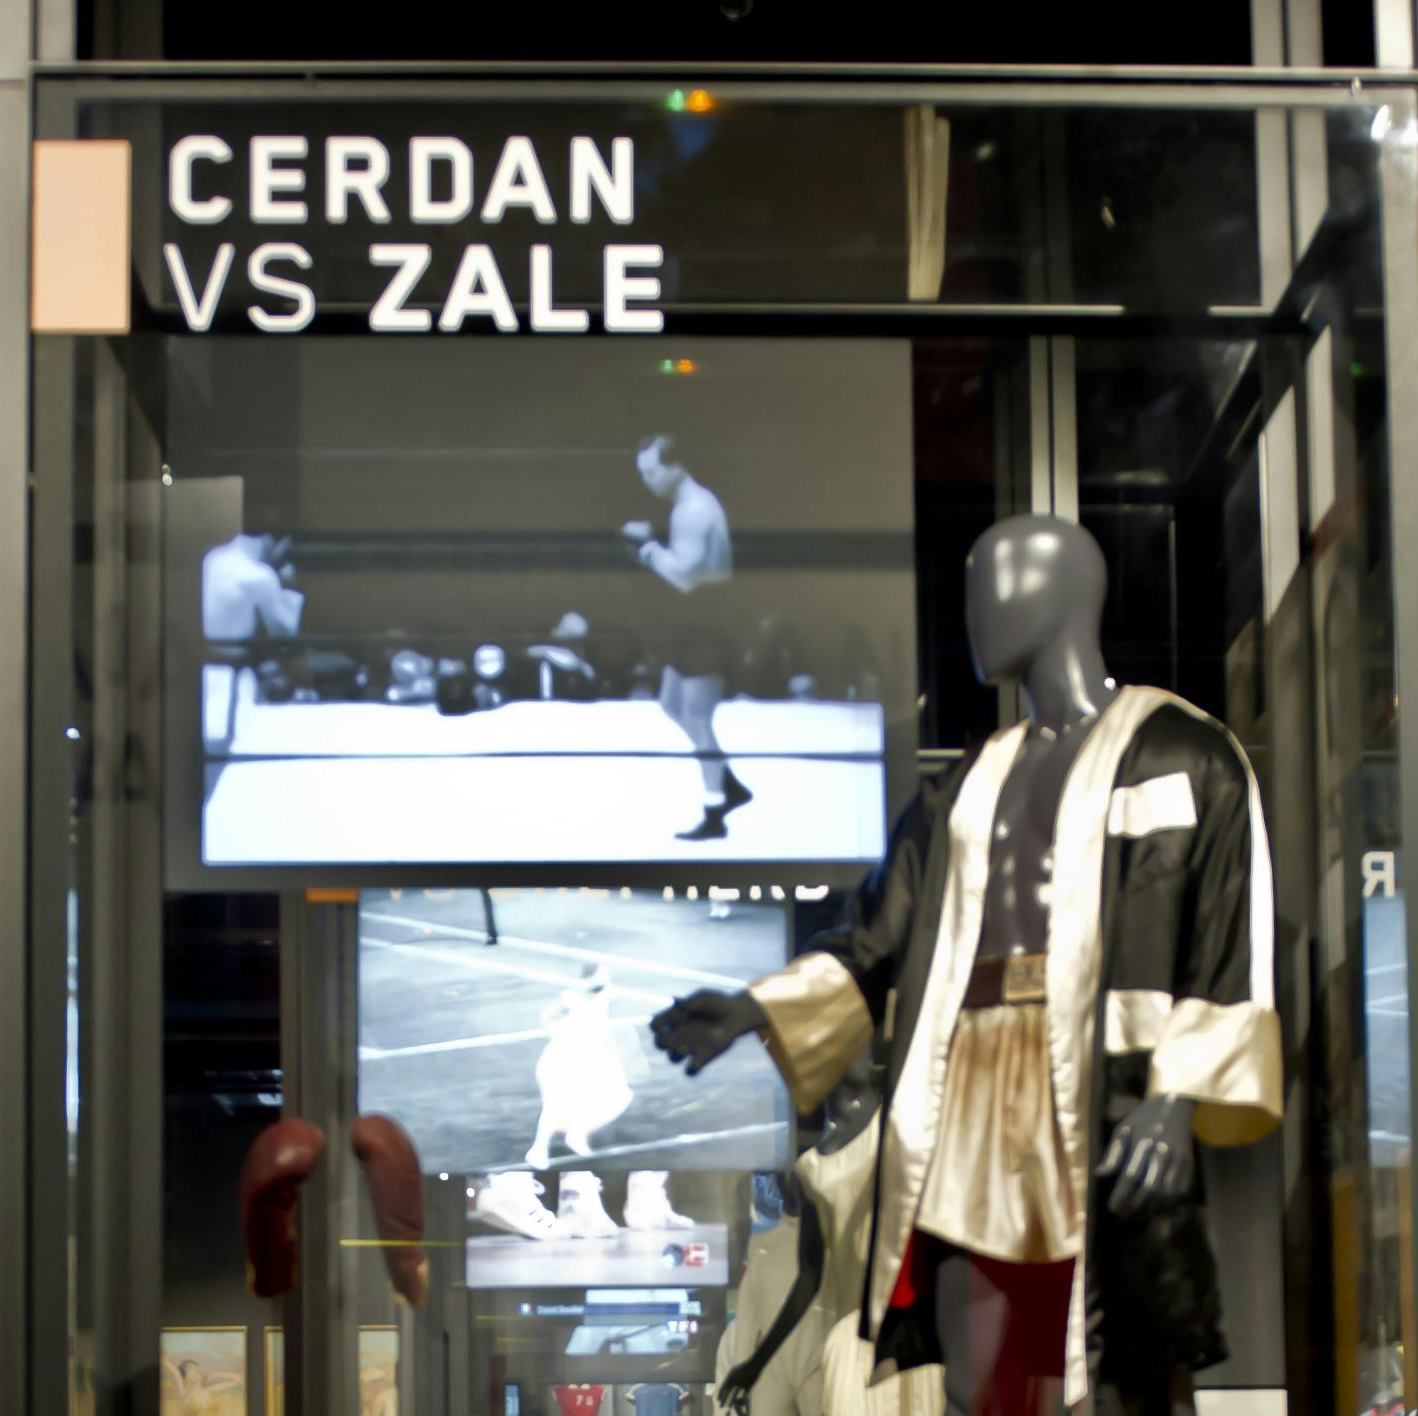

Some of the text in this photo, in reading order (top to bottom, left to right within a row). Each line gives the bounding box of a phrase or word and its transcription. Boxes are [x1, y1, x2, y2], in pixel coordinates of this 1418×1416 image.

[168, 134, 635, 224] CERDAN
[162, 242, 665, 333] VS ZALE
